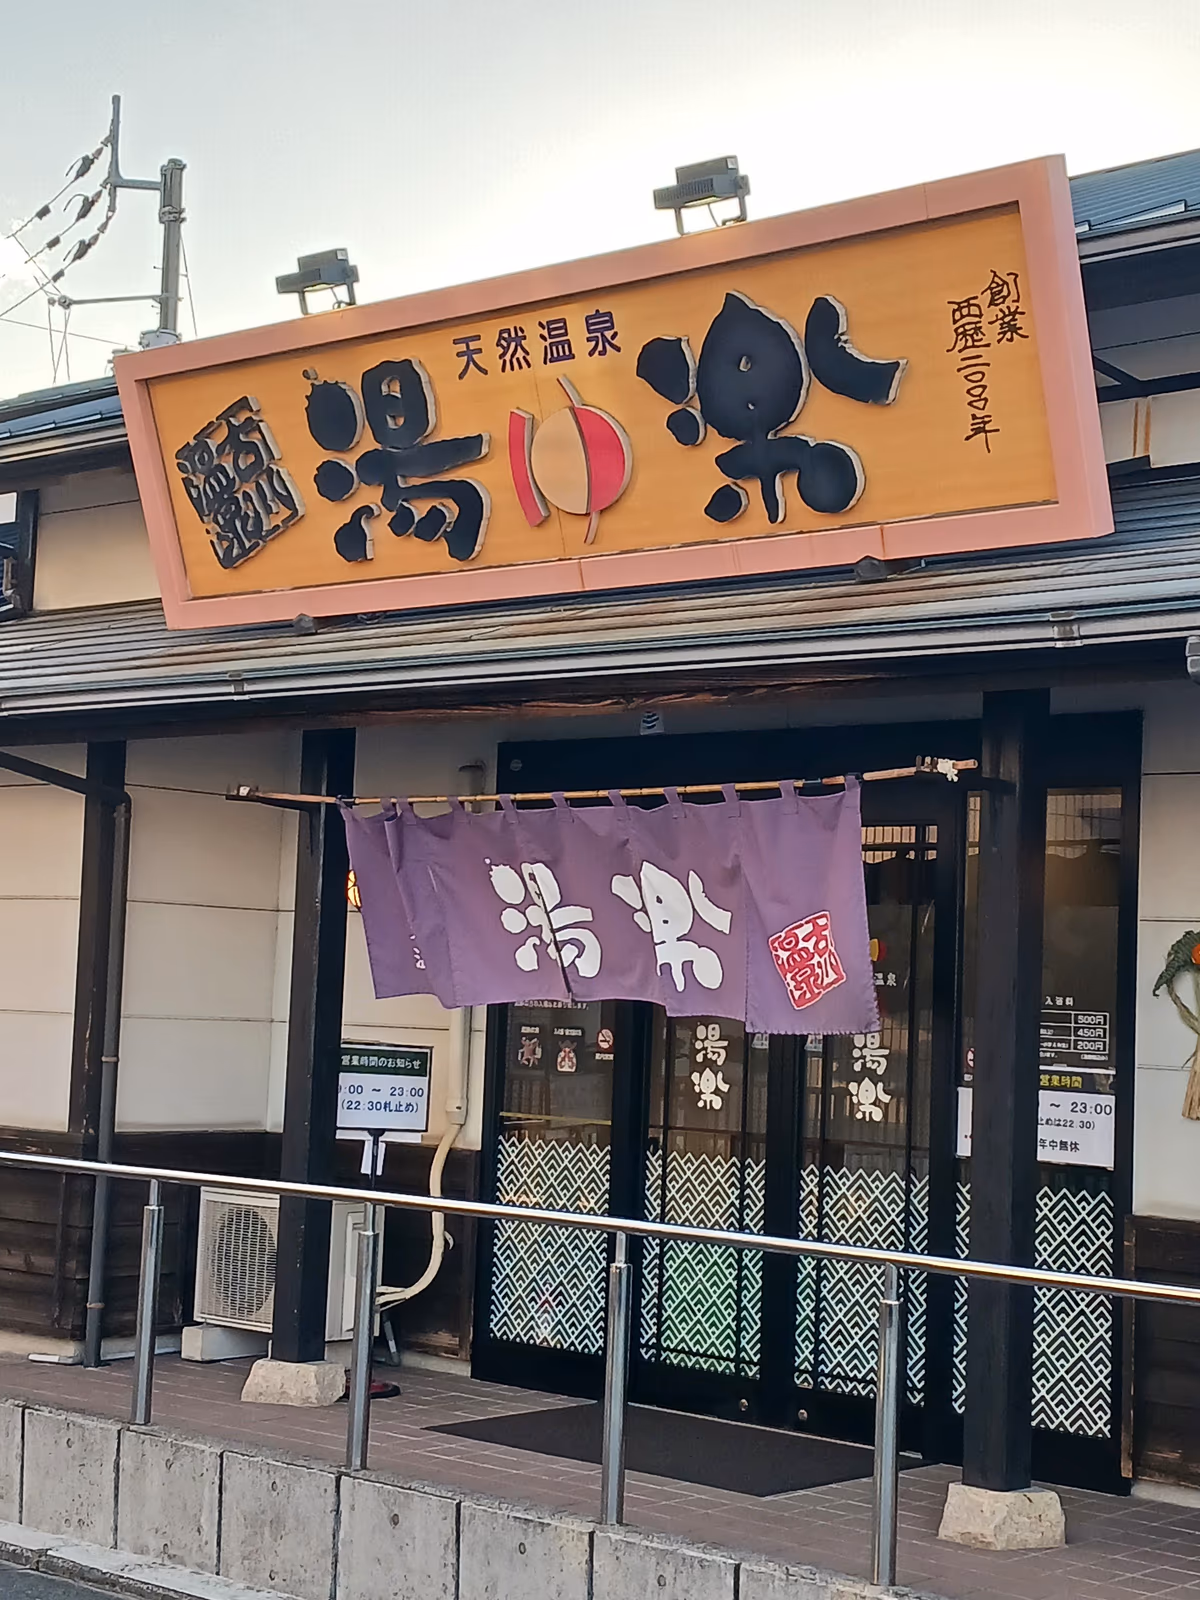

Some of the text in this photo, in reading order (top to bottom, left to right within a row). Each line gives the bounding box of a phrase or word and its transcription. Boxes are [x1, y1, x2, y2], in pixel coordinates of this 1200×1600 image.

[980, 269, 1029, 344] 創業
[452, 308, 622, 381] 天然温泉
[1077, 1015, 1104, 1025] 500円
[1077, 1028, 1104, 1038] 450円
[1076, 1041, 1104, 1051] 200円
[341, 1054, 422, 1069] 営業時間のお知らせ
[1040, 1074, 1083, 1089] 営業時間
[389, 1086, 425, 1098] 23:00
[1070, 1101, 1113, 1116] 23:00
